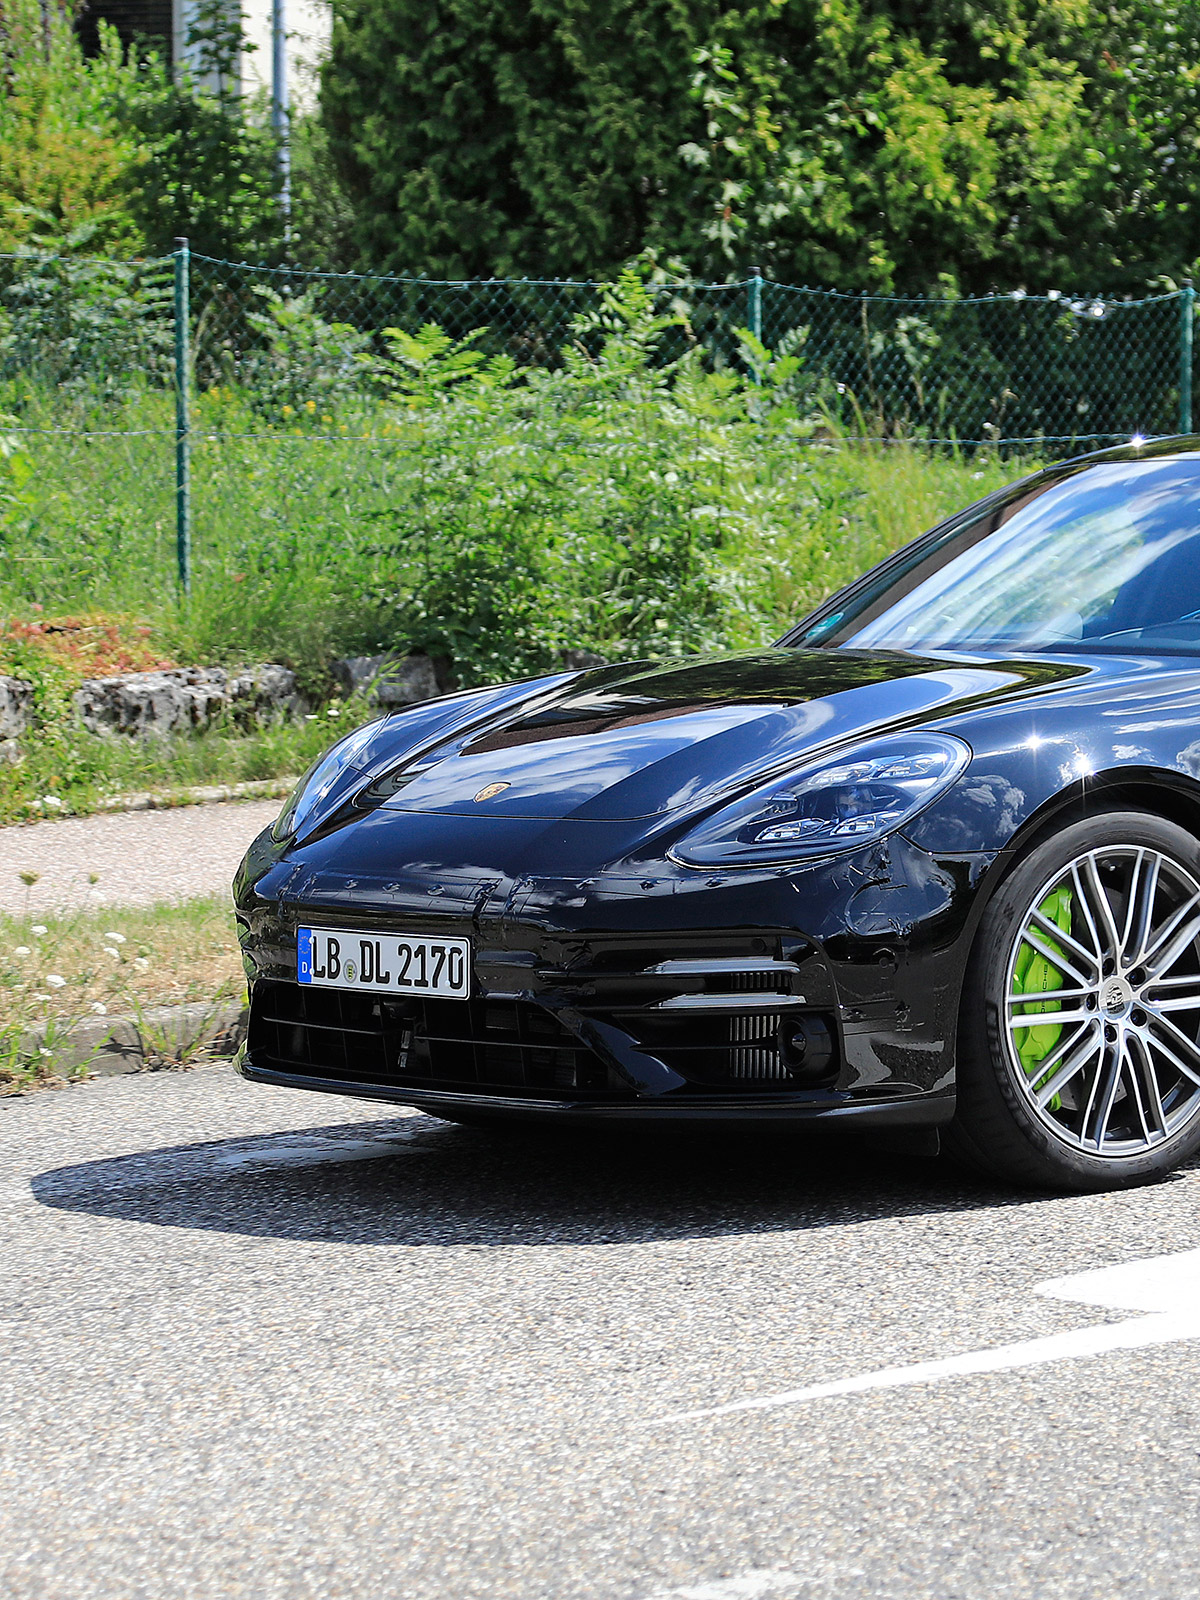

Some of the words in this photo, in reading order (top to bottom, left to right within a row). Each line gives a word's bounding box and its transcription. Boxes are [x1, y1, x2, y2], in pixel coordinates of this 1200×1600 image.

[301, 961, 308, 974] D
[313, 936, 341, 979] LB
[360, 940, 390, 984] DL
[398, 943, 463, 990] 2170
